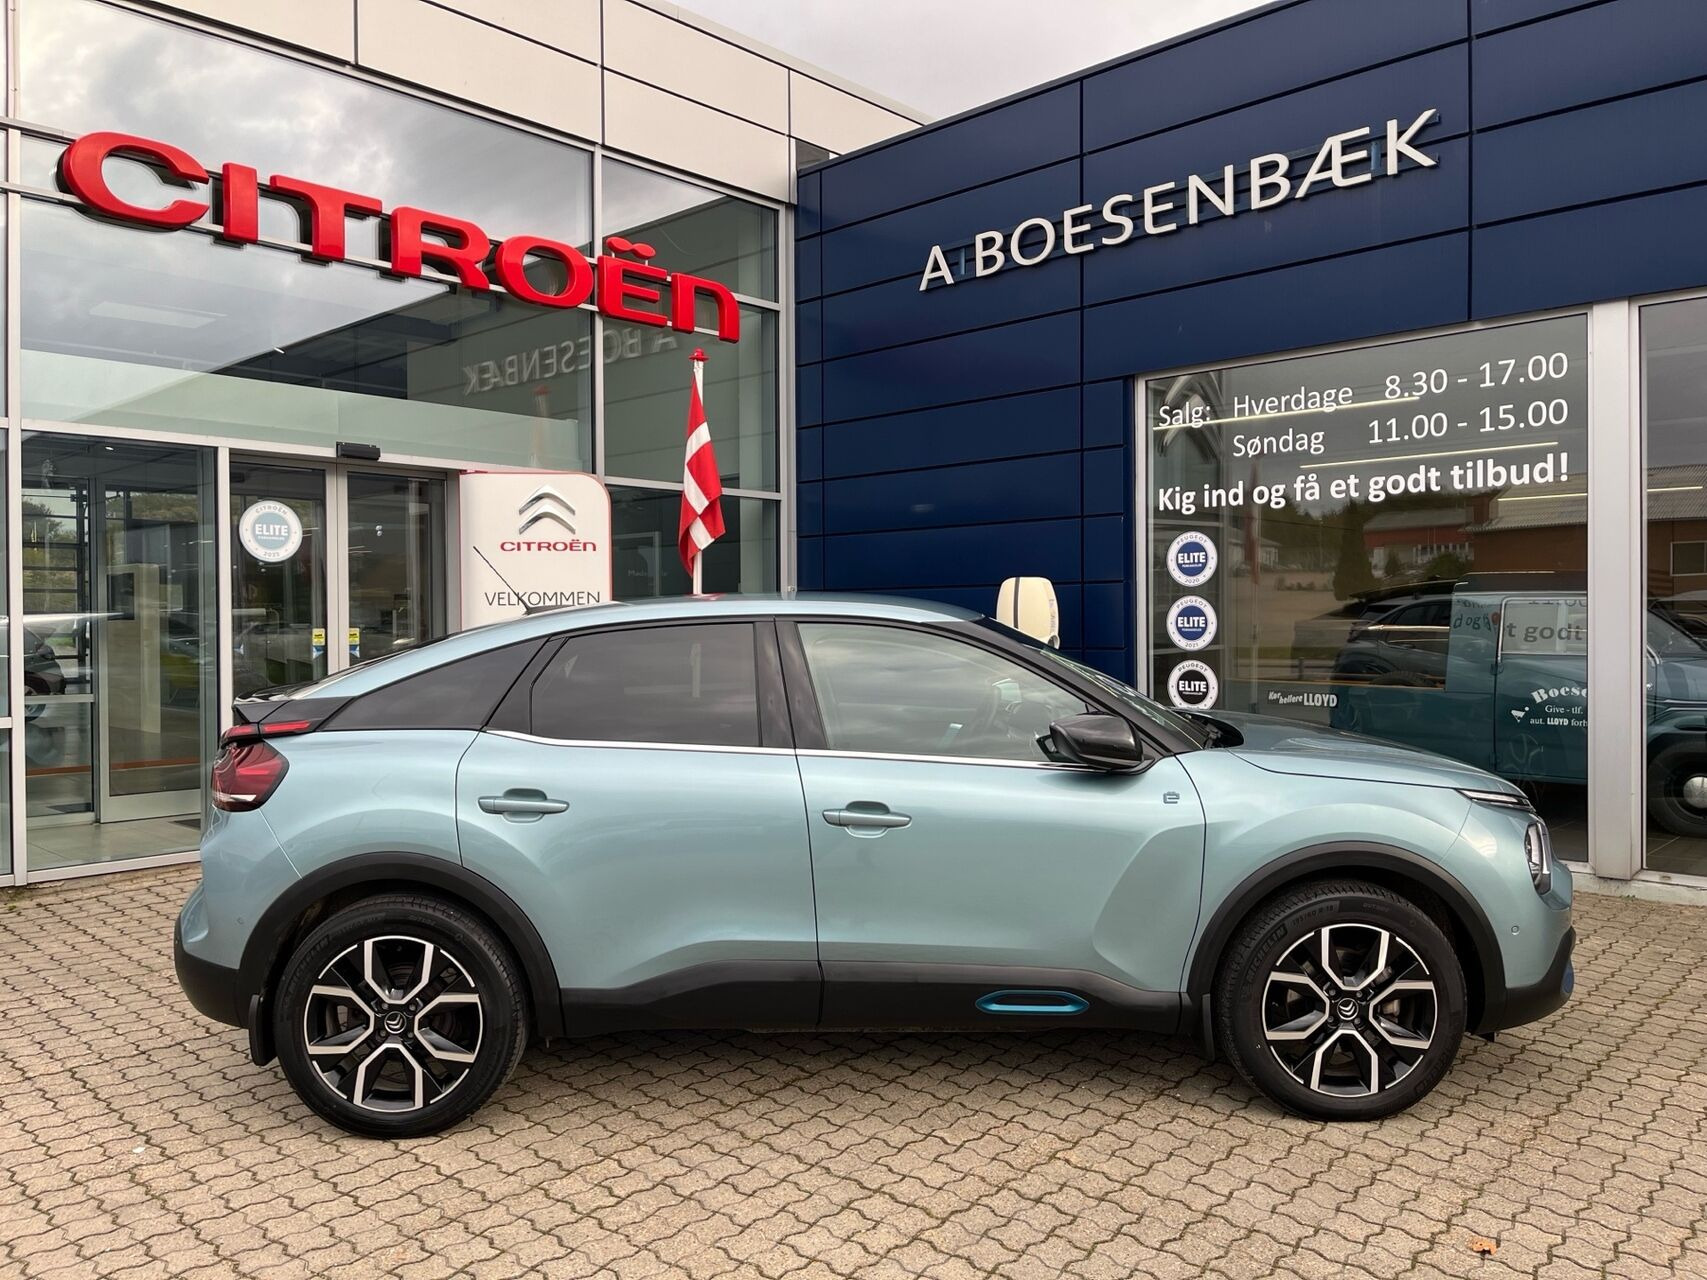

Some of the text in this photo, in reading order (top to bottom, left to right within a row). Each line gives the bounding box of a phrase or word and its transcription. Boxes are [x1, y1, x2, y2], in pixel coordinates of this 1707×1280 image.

[918, 108, 1438, 292] A BOESENBÆK
[1158, 402, 1211, 428] Salg:
[1234, 386, 1353, 417] Hverdage
[1384, 368, 1448, 399] 8.30
[1479, 352, 1568, 388] 17.00
[1232, 428, 1325, 458] Søndag
[1368, 412, 1448, 444] 11.00
[1479, 399, 1569, 432] 15.00
[1158, 452, 1568, 515] Kig ind og få et godt tilbud!
[255, 523, 288, 536] ELITE
[1176, 534, 1208, 546] PEUGEOT
[1177, 551, 1206, 564] ELITE
[484, 591, 600, 607] VELKOMMEN
[1176, 598, 1208, 609] PEUGEOT
[1177, 616, 1206, 628] ELITE
[1177, 662, 1208, 673] PEUGEOT
[1178, 680, 1207, 692] ELITE
[1303, 693, 1338, 707] LLOYD
[1544, 704, 1565, 713] Give
[1571, 706, 1584, 714] tlf.
[1547, 717, 1569, 726] LLOYD
[1246, 922, 1288, 984] MICHELIN
